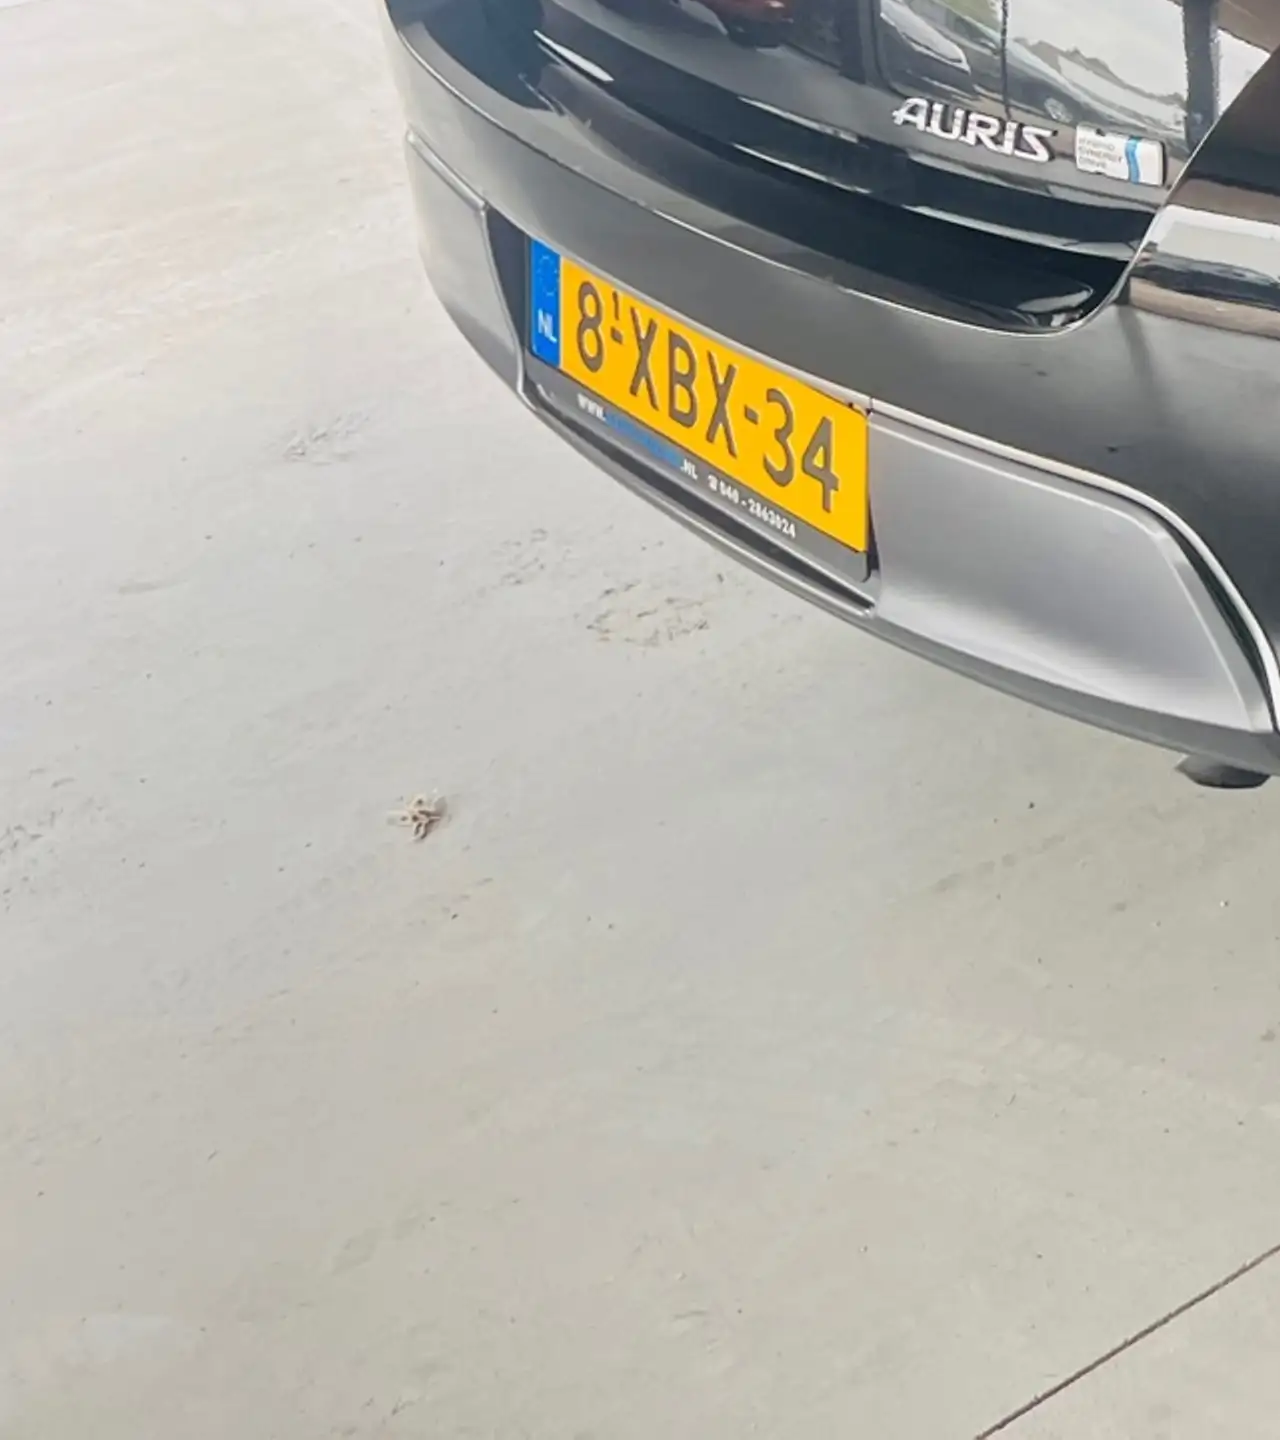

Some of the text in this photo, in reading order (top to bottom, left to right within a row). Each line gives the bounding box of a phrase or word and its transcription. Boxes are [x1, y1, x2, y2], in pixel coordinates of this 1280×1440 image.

[891, 97, 1053, 162] AURIS
[537, 308, 558, 343] NL
[576, 281, 840, 514] 8-XBX-34
